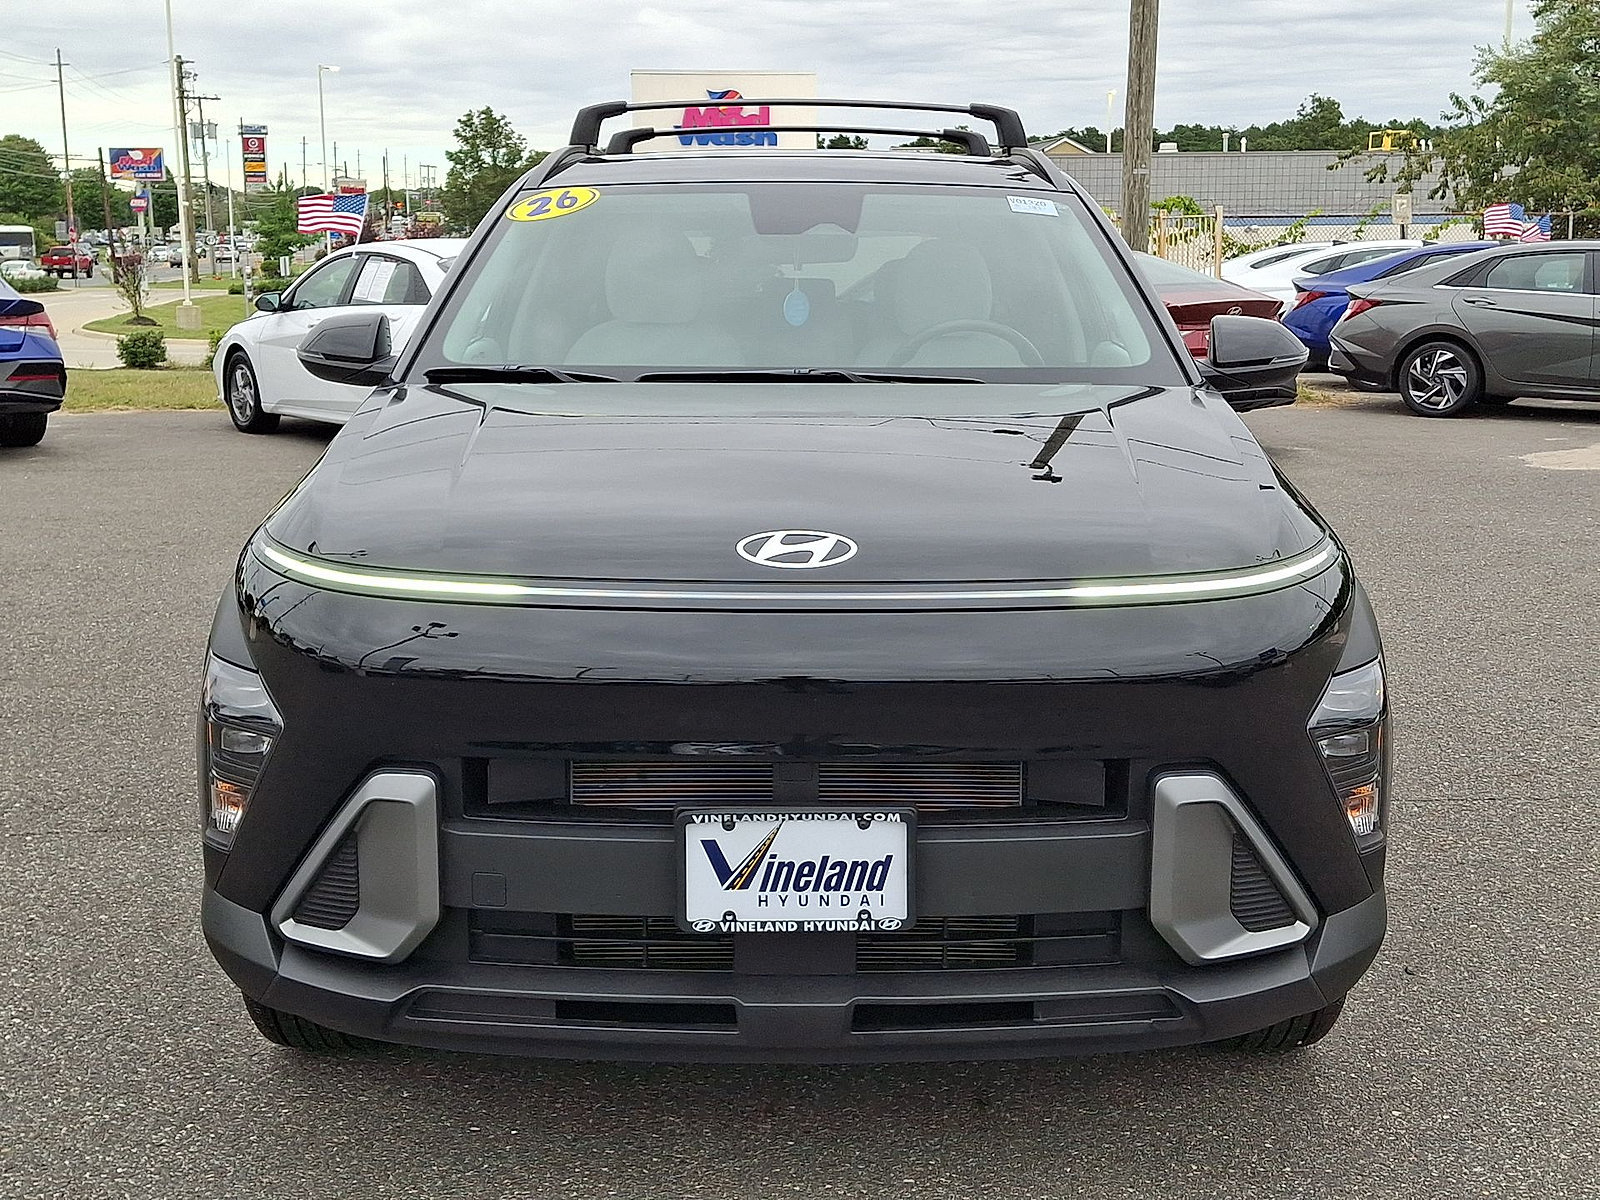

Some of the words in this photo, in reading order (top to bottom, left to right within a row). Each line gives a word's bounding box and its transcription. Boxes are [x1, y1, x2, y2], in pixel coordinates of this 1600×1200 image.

[682, 105, 770, 128] Mod
[676, 130, 778, 146] Wash
[119, 156, 153, 165] Mod
[526, 190, 578, 216] 26
[691, 813, 900, 824] VINELANDHYUNDAI.COM
[700, 824, 893, 893] Vineland
[758, 894, 884, 907] HYUNDAI
[719, 921, 798, 932] VINELAND
[803, 920, 876, 931] HYUNDAI
